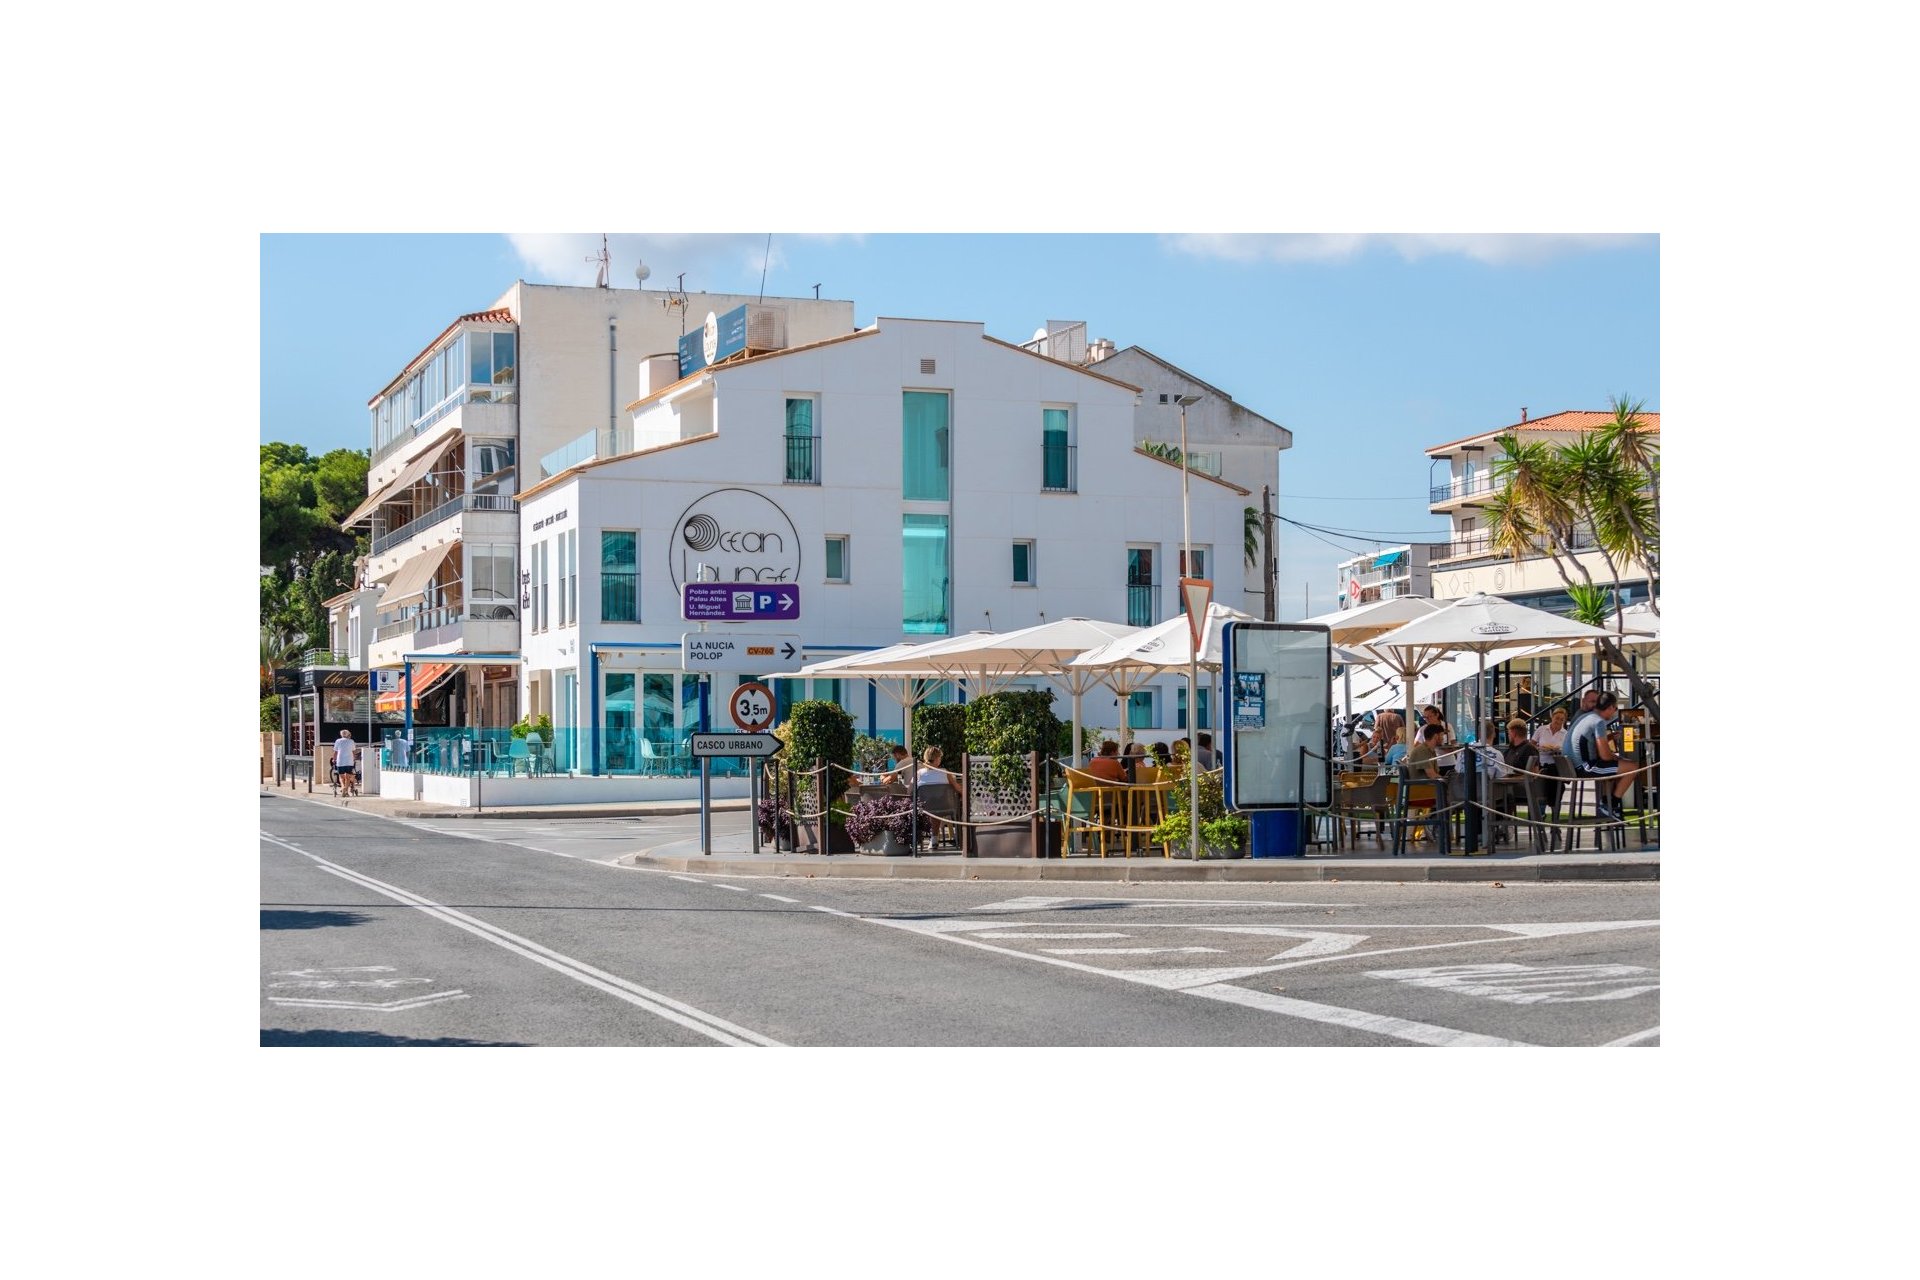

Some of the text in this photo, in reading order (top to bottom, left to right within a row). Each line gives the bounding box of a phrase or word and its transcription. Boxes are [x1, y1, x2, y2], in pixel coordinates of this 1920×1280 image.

[759, 595, 772, 610] P
[690, 641, 735, 650] LA NUCIA
[747, 647, 775, 655] CV-760
[690, 652, 723, 660] POLOP
[697, 740, 764, 750] CASCO URBANO
